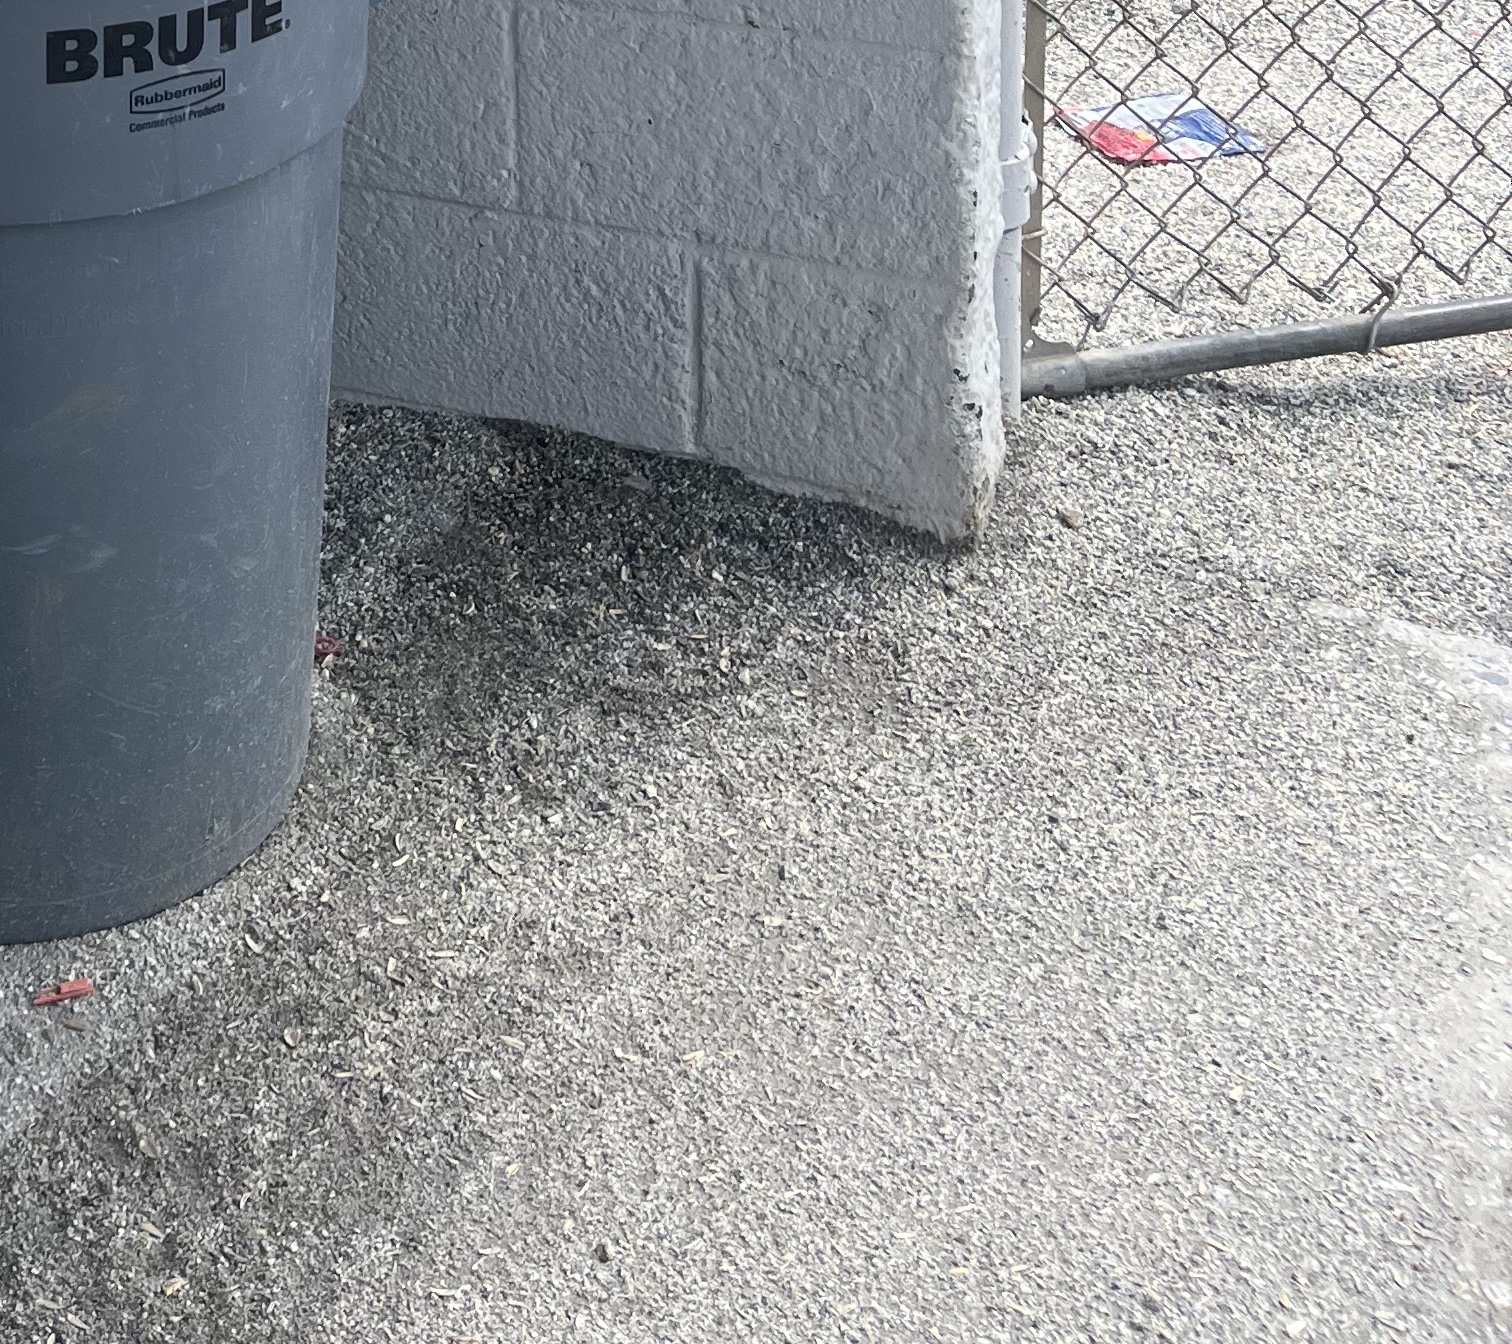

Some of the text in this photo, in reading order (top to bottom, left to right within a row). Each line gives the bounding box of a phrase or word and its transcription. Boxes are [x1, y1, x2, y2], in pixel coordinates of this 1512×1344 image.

[134, 75, 223, 107] Rubbermaid
[129, 101, 226, 133] Commercial Products
